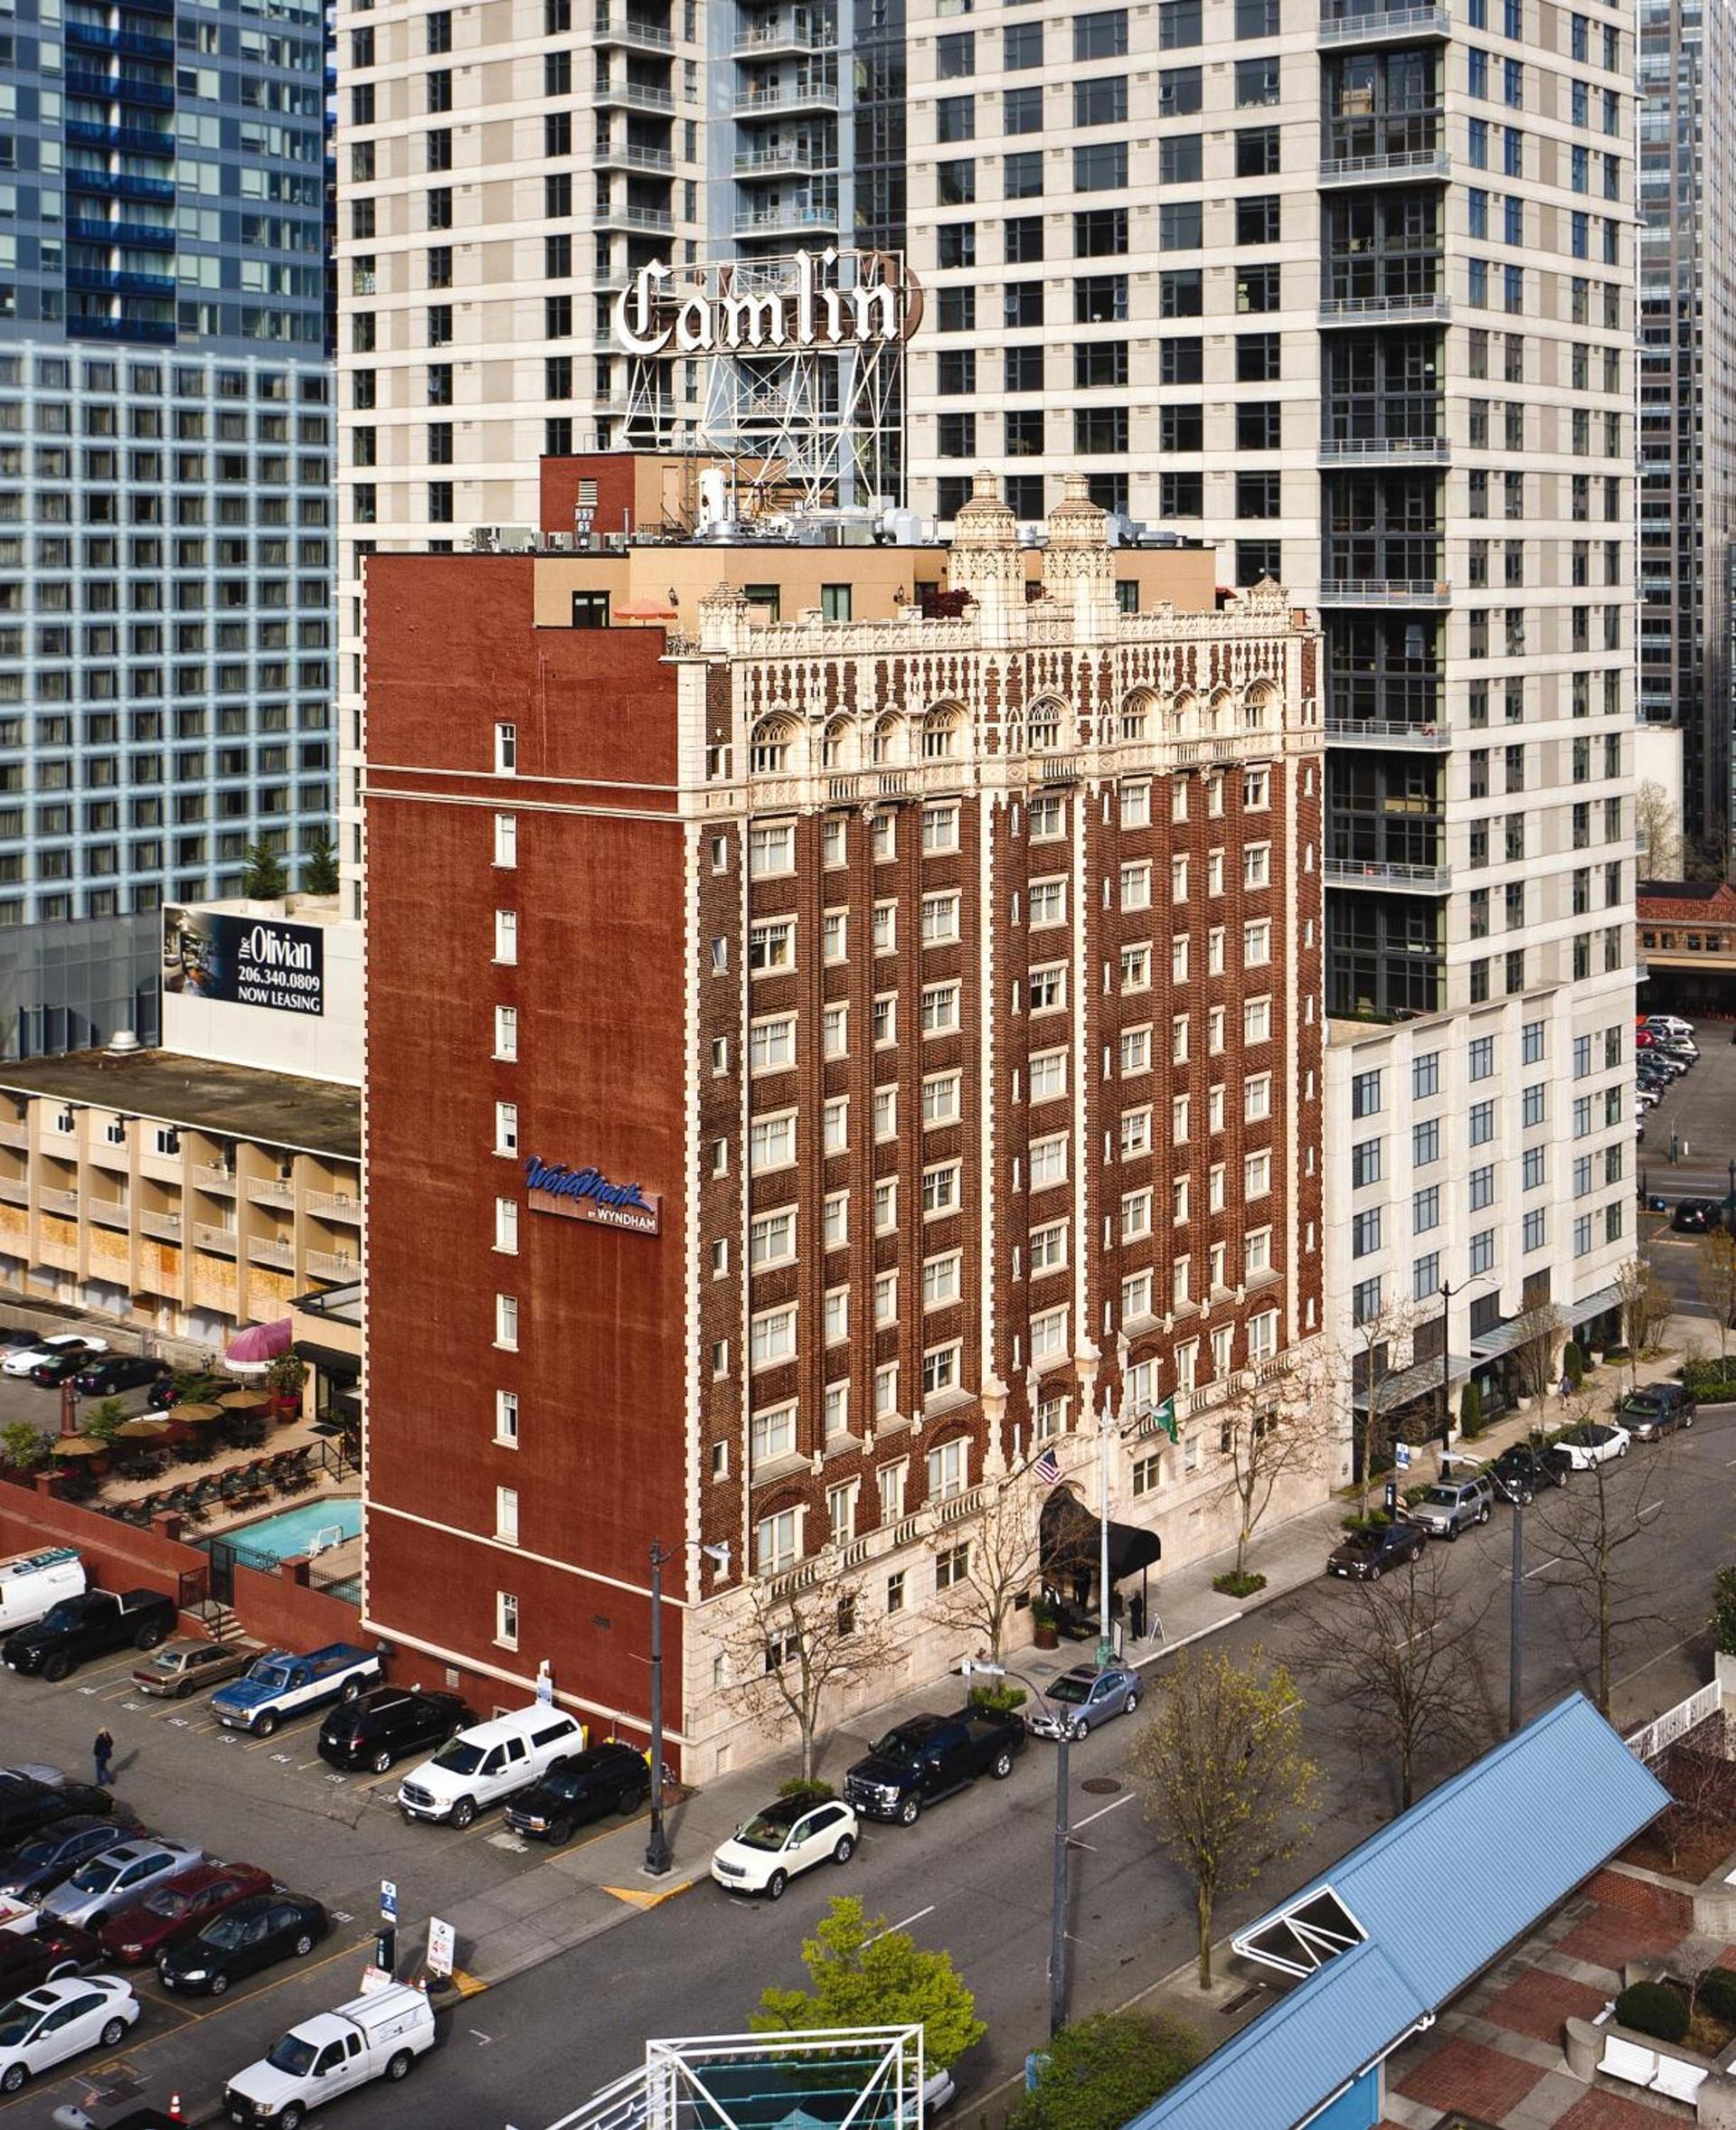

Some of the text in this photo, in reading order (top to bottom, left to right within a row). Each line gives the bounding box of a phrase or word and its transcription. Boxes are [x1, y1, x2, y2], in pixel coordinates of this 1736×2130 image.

[615, 246, 903, 355] Camlin
[238, 925, 312, 970] The Olivian
[238, 966, 321, 992] 206.340.0809
[238, 985, 321, 1012] NOW LEASING
[524, 1155, 655, 1213] WorldMark
[597, 1209, 656, 1230] WYNDHAM
